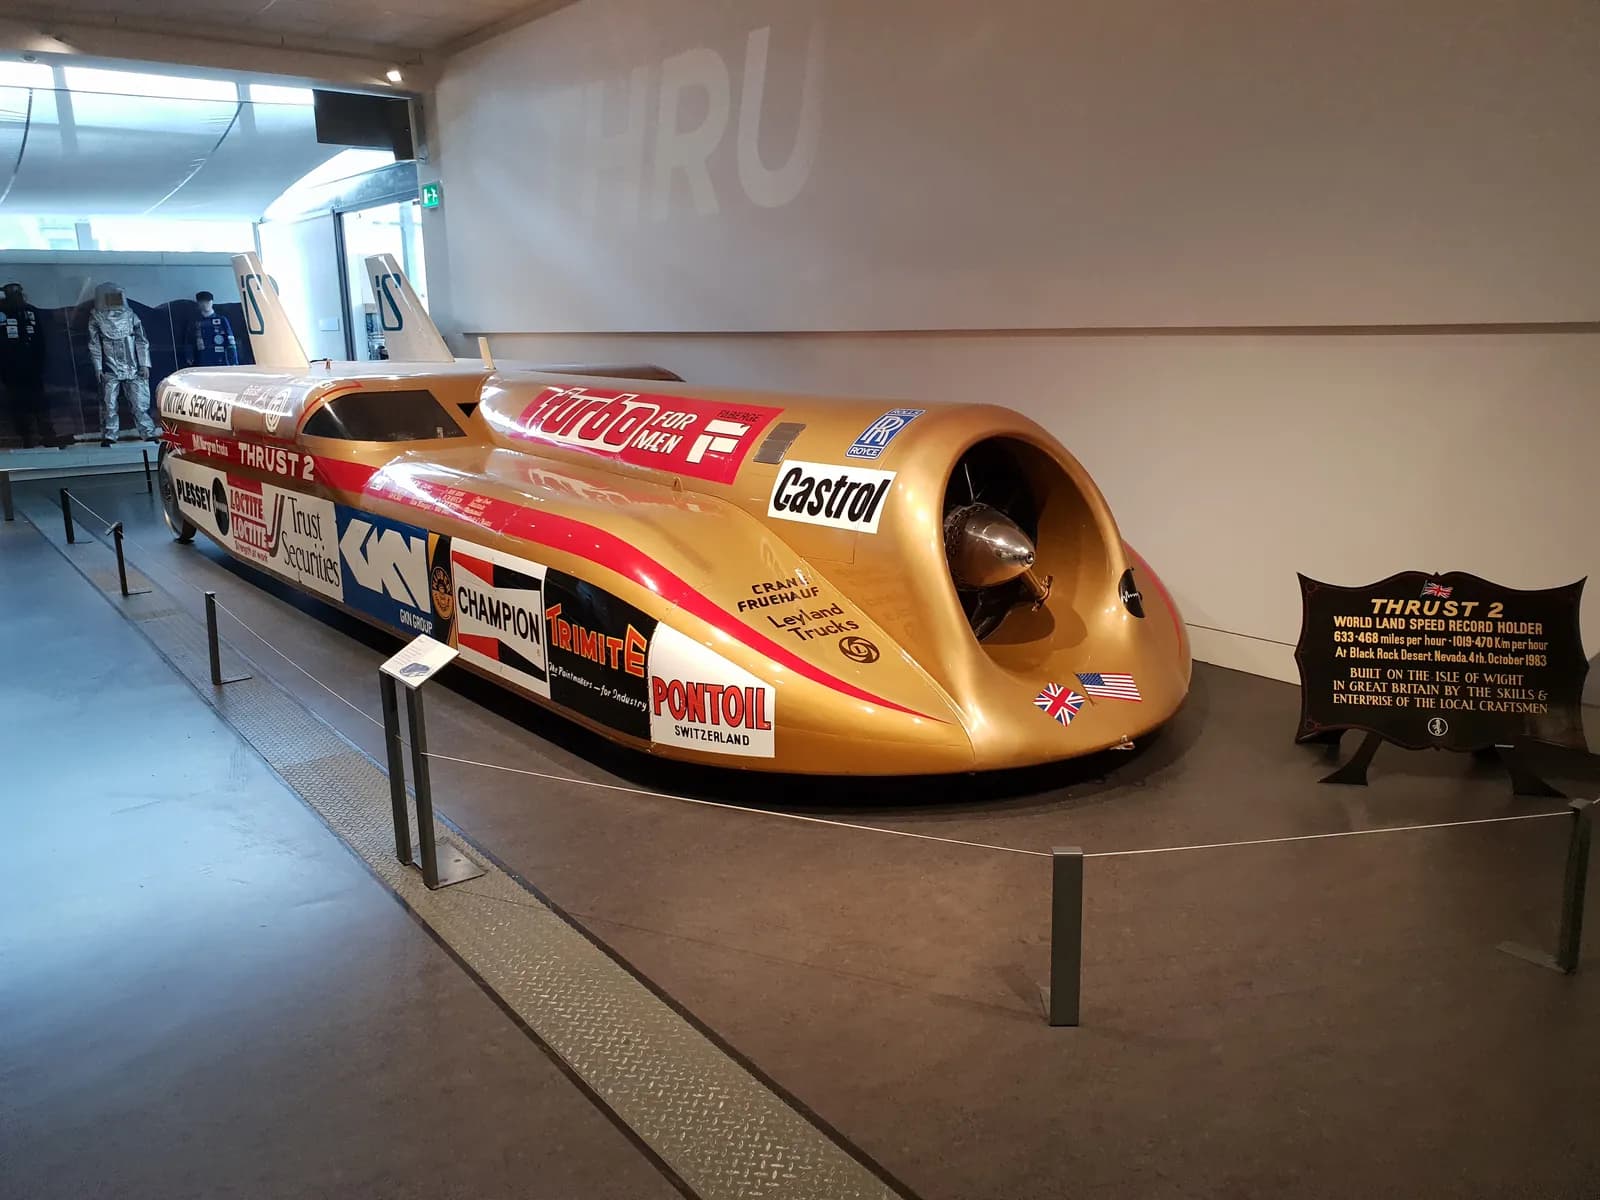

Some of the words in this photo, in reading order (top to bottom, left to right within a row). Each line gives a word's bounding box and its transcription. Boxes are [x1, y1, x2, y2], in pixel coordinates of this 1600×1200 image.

[188, 394, 229, 422] SERVICES
[652, 411, 697, 431] FOR
[631, 430, 683, 454] MEN
[850, 446, 879, 456] ROYCE
[238, 442, 299, 477] THRUST
[302, 455, 315, 481] 2
[176, 478, 212, 513] PLESSEY
[230, 489, 264, 520] LOCTITE
[773, 467, 891, 522] Castrol
[287, 496, 322, 541] Trust
[233, 515, 270, 550] LOCTITE
[281, 530, 340, 587] Securities
[751, 573, 809, 595] CRAN
[737, 586, 820, 612] FRUEHAUF
[1371, 598, 1479, 617] THRUST
[1487, 602, 1504, 618] 2
[399, 608, 412, 629] GKN
[412, 614, 433, 635] GROUP
[458, 586, 540, 645] CHAMPION
[767, 602, 844, 628] Leyland
[1333, 615, 1373, 629] WORLD
[1376, 617, 1406, 630] LAND
[1409, 618, 1446, 632] SPEED
[1449, 620, 1493, 633] RECORD
[1497, 621, 1543, 635] HOLDER
[545, 602, 648, 678] TRIMITE
[787, 618, 860, 641] Trucks
[1380, 633, 1405, 645] miles
[1406, 636, 1422, 647] per
[1424, 634, 1446, 647] hour
[1511, 640, 1527, 652] per
[1528, 638, 1549, 650] hour
[1335, 646, 1347, 658] At
[1349, 647, 1375, 659] Black
[1377, 648, 1399, 660] Rock
[1488, 652, 1524, 665] October
[1525, 654, 1547, 667] 1983
[558, 667, 593, 689] Paintmakers
[612, 688, 647, 712] Industry
[1350, 667, 1382, 679] BUILT
[1386, 669, 1403, 680] ON
[1408, 670, 1430, 681] THE
[1436, 671, 1460, 683] ISLE
[1465, 672, 1480, 684] OF
[1483, 673, 1524, 686] WIGHT
[652, 675, 772, 731] PONTOIL
[1333, 680, 1345, 691] IN
[1349, 681, 1388, 693] GREAT
[1392, 682, 1439, 695] BRITAIN
[1444, 685, 1461, 696] BY
[1466, 686, 1491, 698] THE
[1497, 688, 1535, 701] SKILLS
[1538, 689, 1549, 701] &
[1333, 693, 1393, 706] ENTERPRISE
[1396, 696, 1410, 707] OF
[1414, 697, 1436, 709] THE
[1440, 698, 1476, 711] LOCAL
[1479, 700, 1548, 714] CRAFTSMEN
[675, 724, 750, 746] SWITZERLAND
